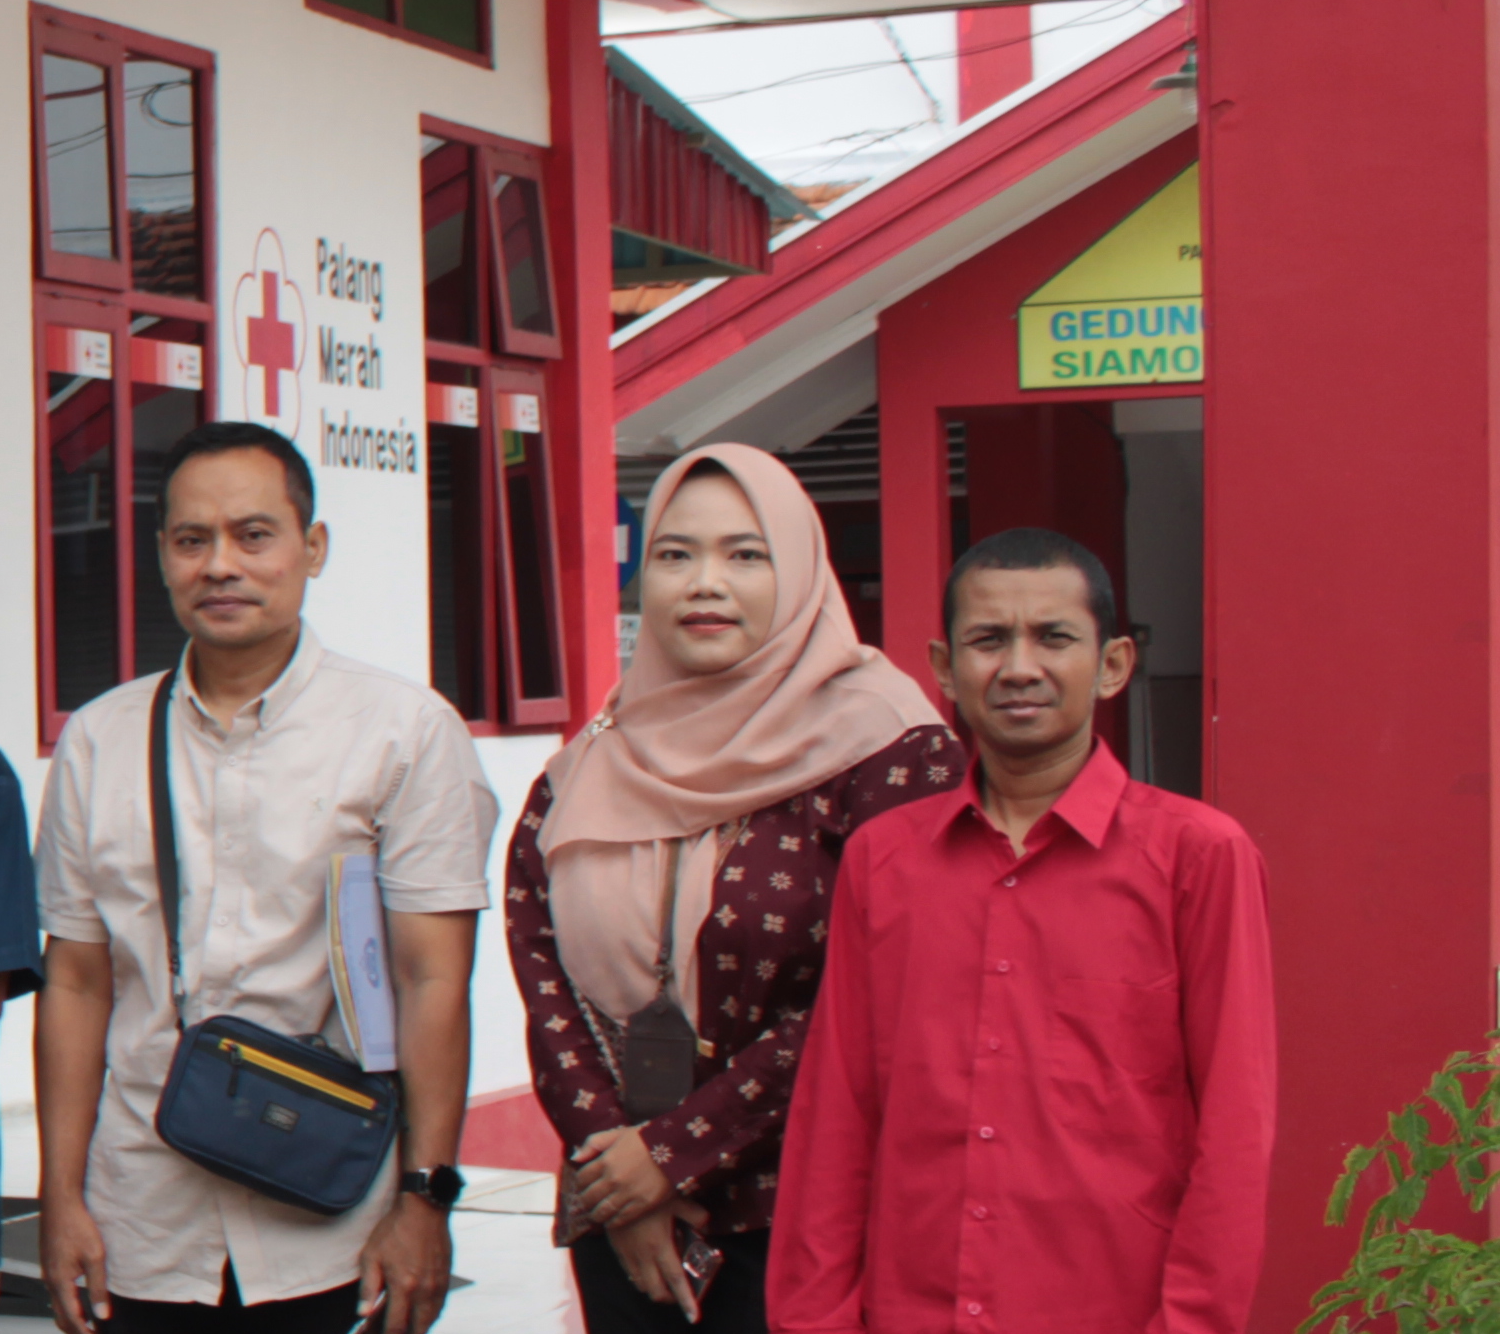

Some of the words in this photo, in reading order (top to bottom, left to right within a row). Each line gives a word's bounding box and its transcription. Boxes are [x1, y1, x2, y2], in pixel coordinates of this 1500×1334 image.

[316, 237, 384, 323] Palang
[1051, 304, 1205, 342] GEDUN
[318, 324, 383, 391] Merah
[319, 407, 418, 474] Indonesia
